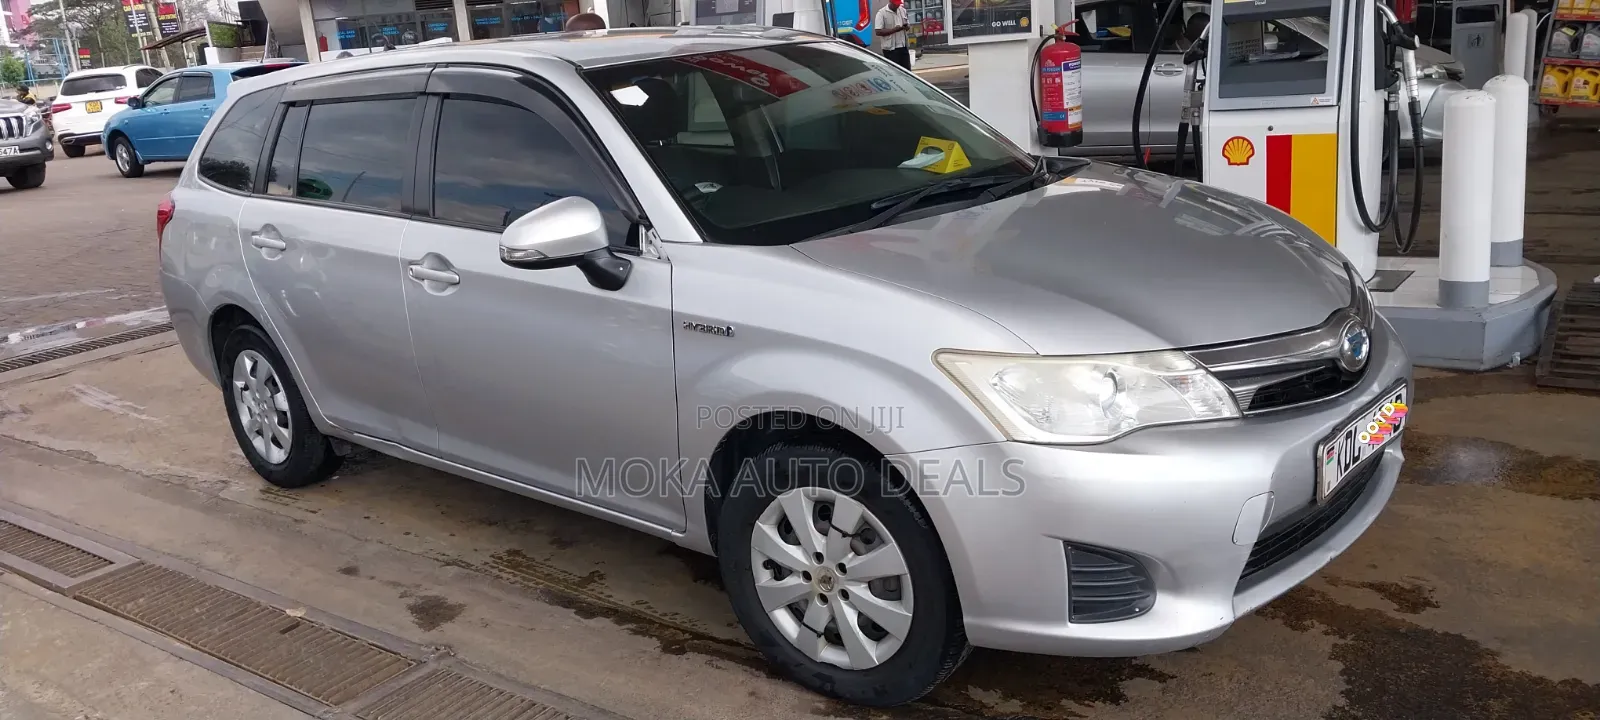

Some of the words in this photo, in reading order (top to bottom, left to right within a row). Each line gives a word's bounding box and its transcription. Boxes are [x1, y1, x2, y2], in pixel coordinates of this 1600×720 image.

[1001, 19, 1017, 27] WILL
[683, 320, 727, 337] HYBRID
[1337, 425, 1361, 482] KDL
